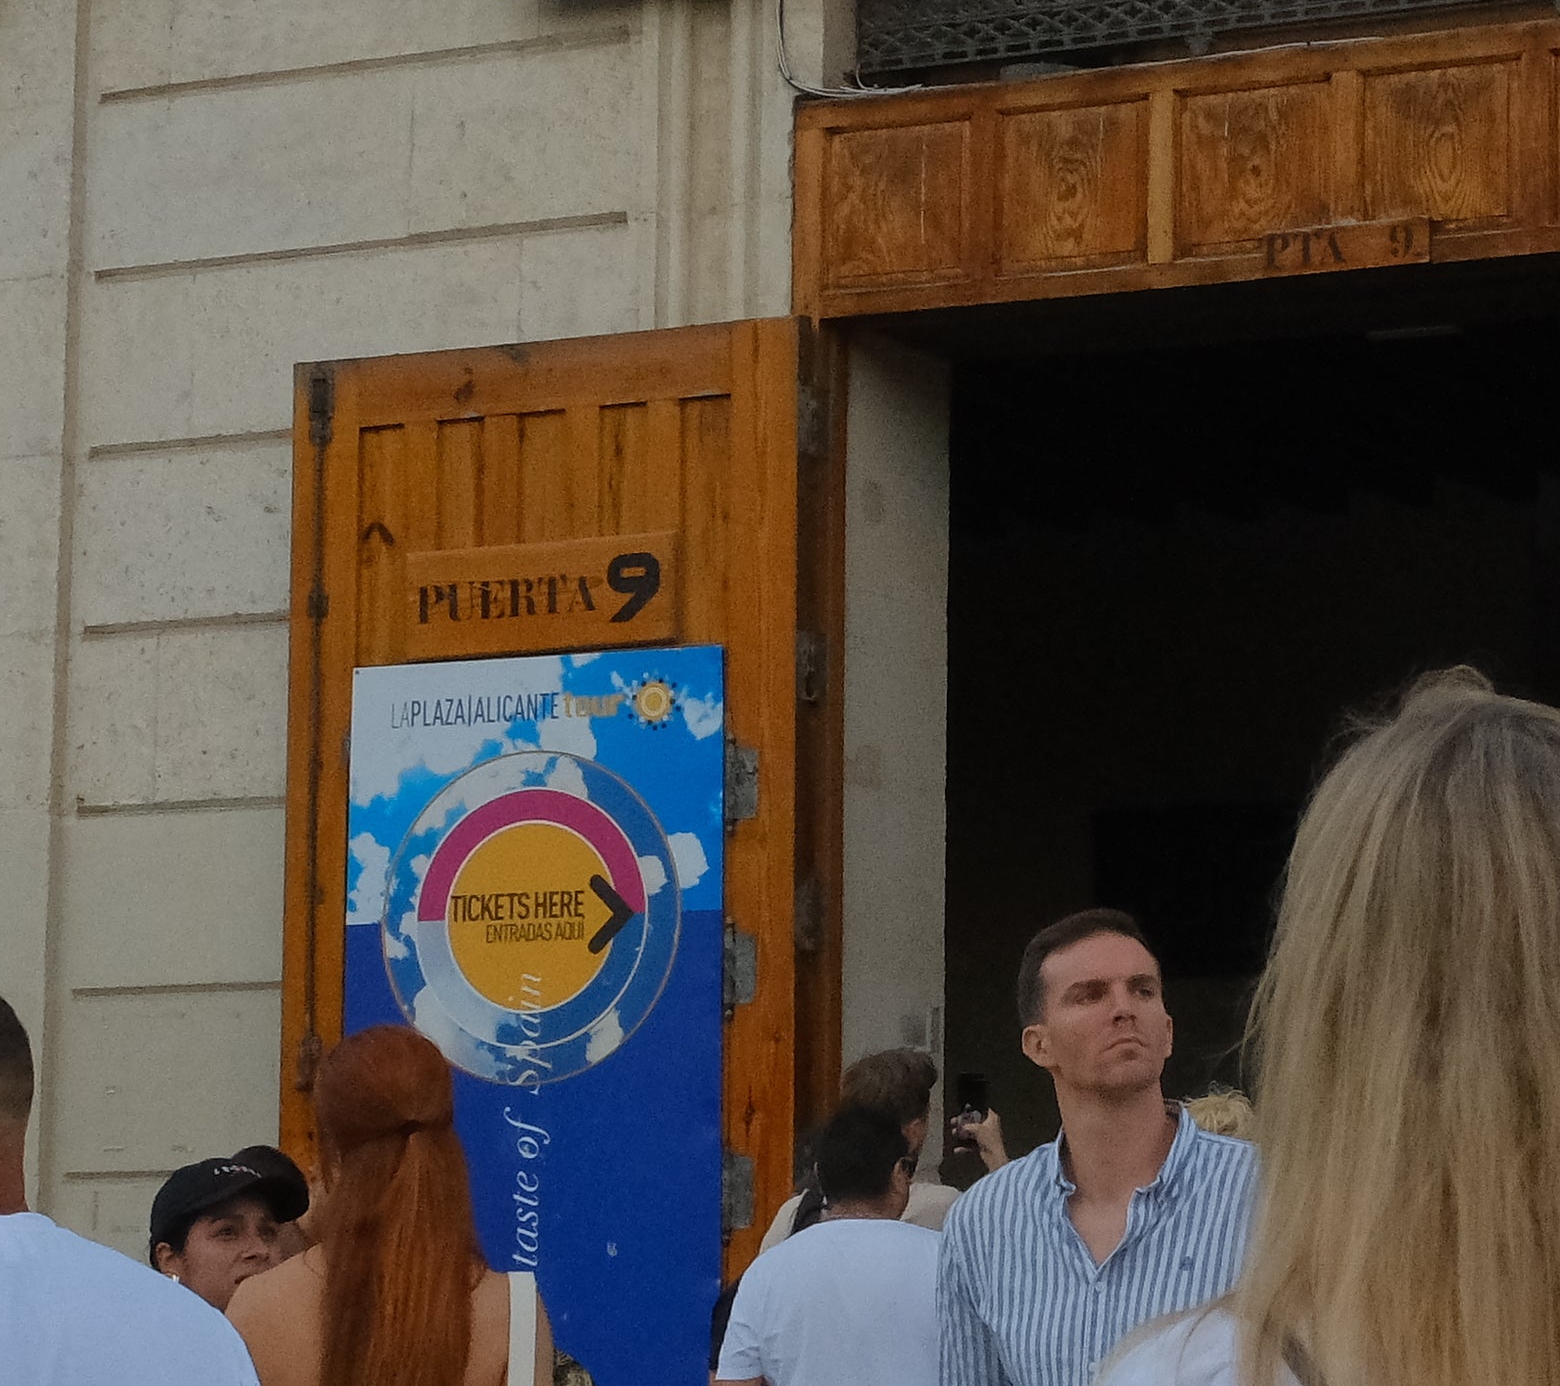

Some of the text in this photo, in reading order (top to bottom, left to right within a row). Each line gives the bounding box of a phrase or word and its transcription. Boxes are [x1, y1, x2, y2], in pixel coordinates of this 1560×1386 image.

[416, 551, 662, 626] PUERTA 9
[562, 690, 623, 719] tour
[450, 890, 585, 924] TICKETS HERE
[485, 922, 552, 944] ENTRADAS
[503, 972, 554, 1271] taste of Spain
